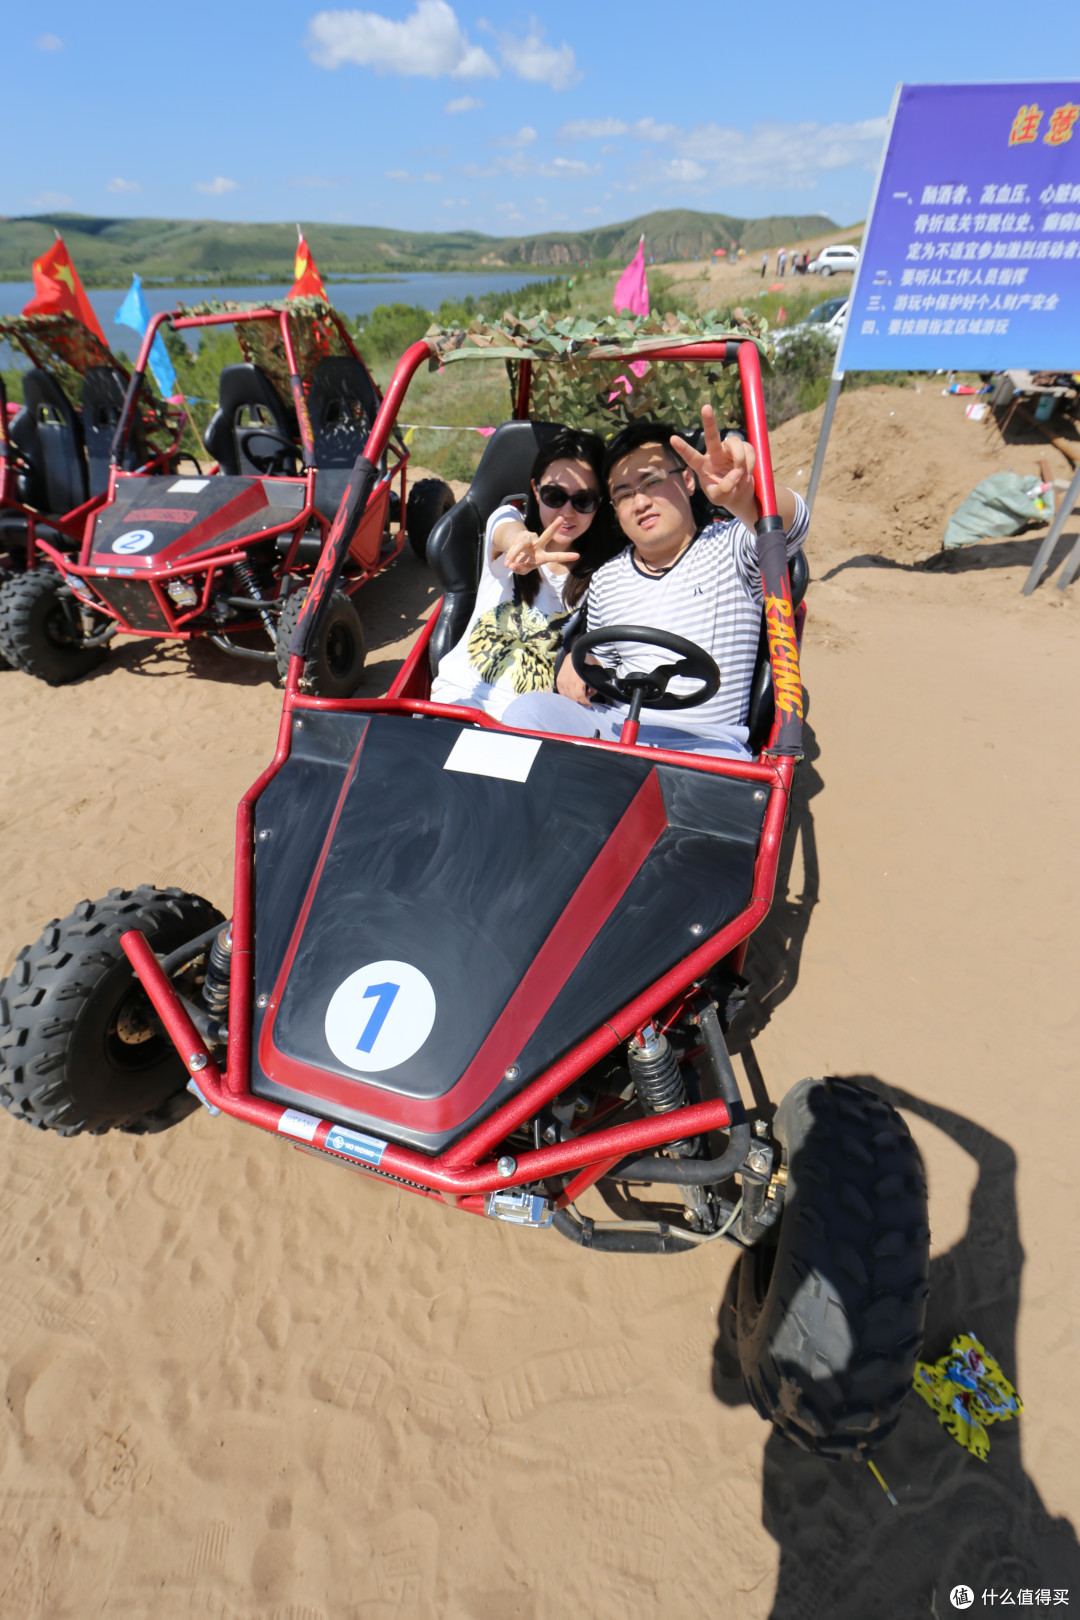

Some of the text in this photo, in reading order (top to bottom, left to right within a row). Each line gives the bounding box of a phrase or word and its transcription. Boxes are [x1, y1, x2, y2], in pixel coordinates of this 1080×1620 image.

[1009, 103, 1080, 146] 注意
[119, 534, 145, 550] 2
[765, 596, 803, 718] RACING
[355, 981, 401, 1054] 1
